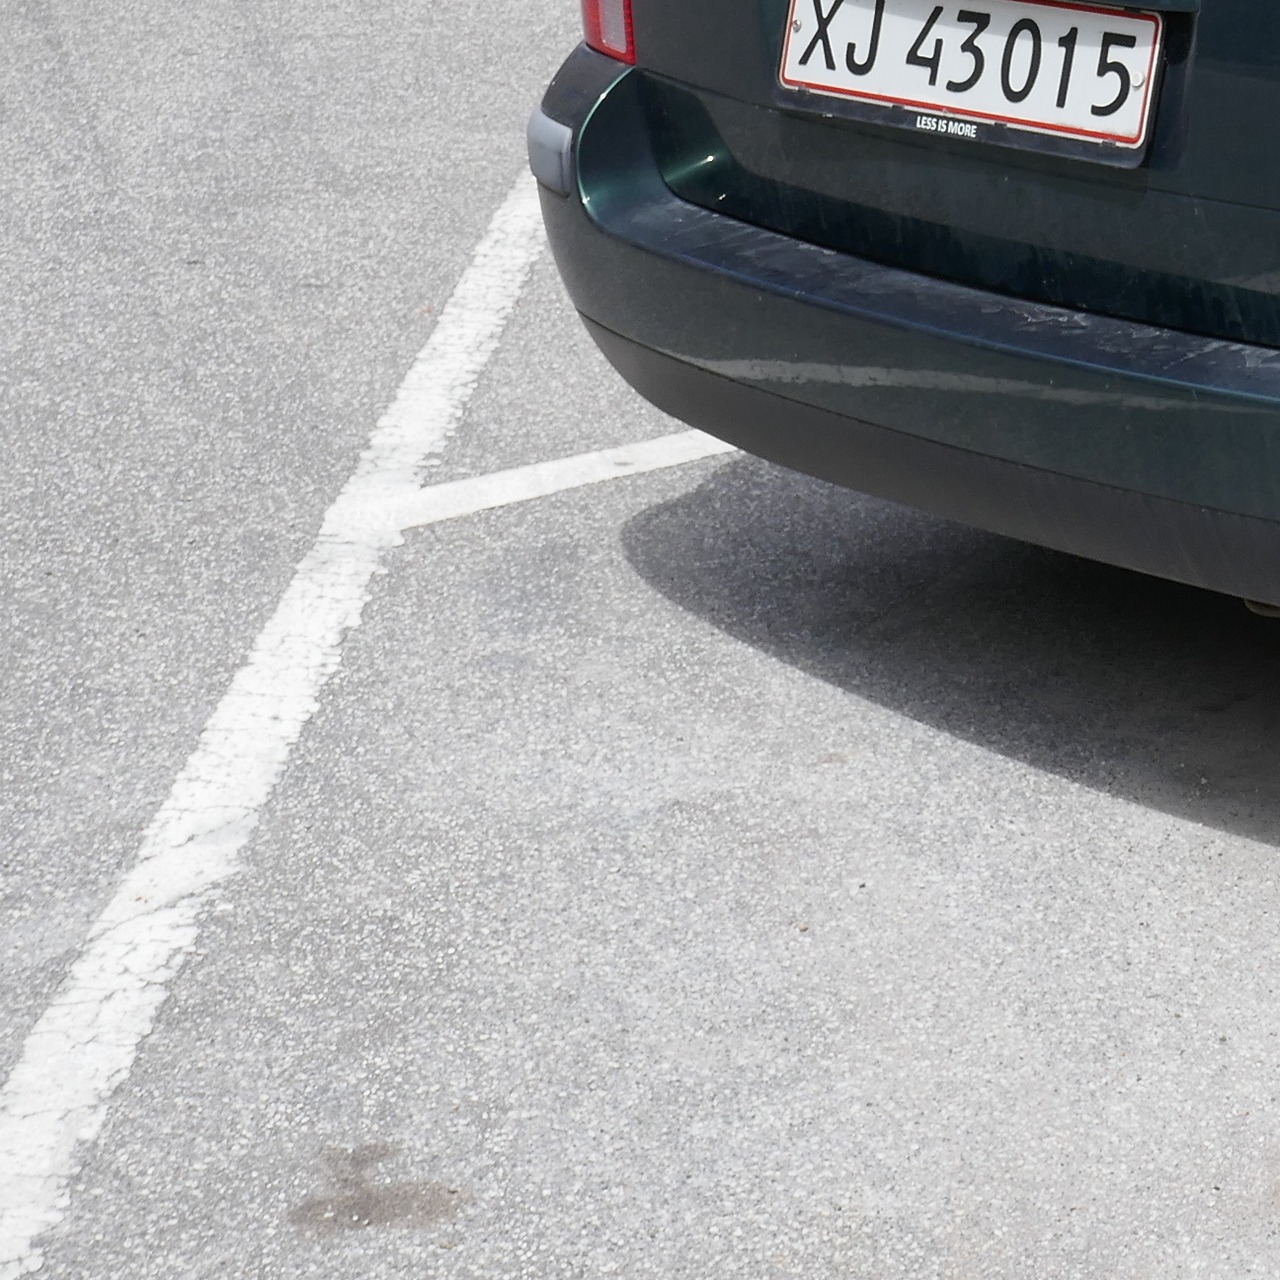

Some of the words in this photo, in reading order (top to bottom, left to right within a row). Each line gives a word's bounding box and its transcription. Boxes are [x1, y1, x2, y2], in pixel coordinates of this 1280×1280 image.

[905, 5, 1137, 117] 43015
[916, 116, 937, 130] LESS
[937, 119, 947, 132] IS
[947, 121, 977, 137] MORE
